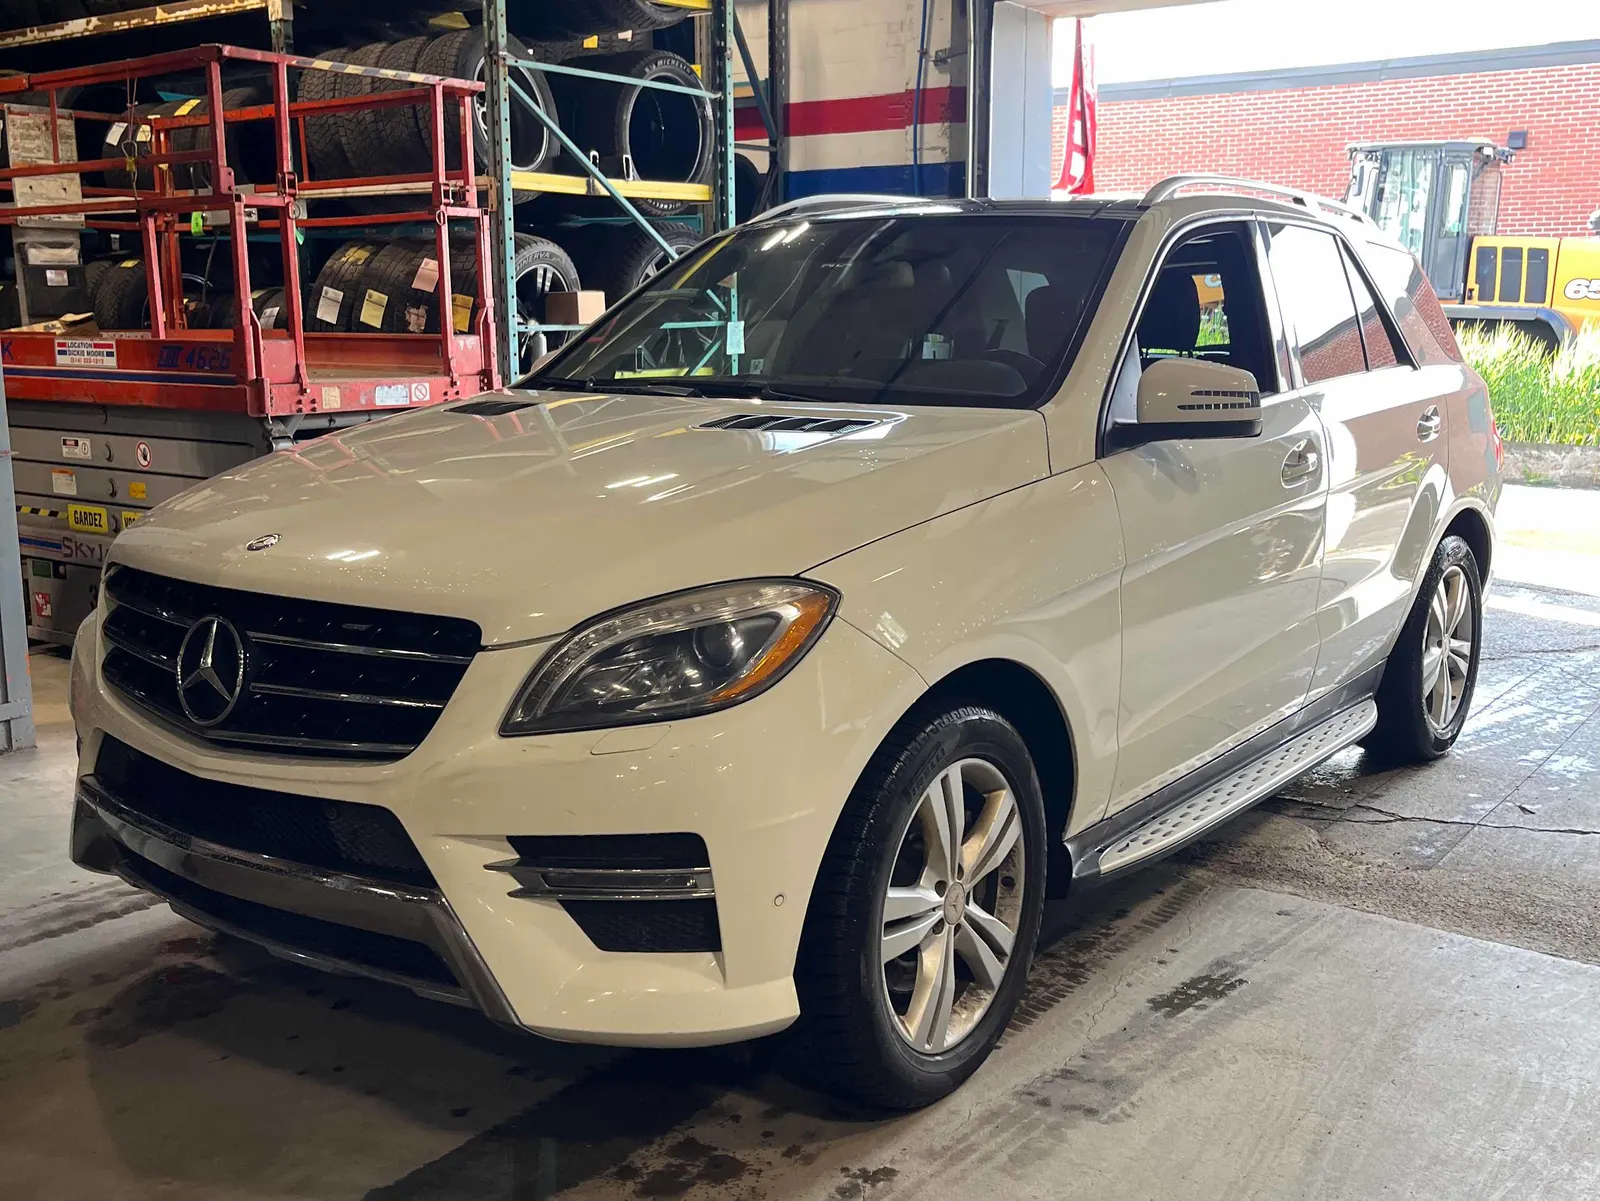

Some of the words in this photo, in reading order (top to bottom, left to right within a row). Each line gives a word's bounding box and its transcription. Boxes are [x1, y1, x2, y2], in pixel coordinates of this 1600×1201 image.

[657, 59, 691, 75] MICHELIN
[515, 252, 550, 271] INERVA
[68, 341, 93, 349] LOCATION
[73, 509, 104, 528] GARDEZ
